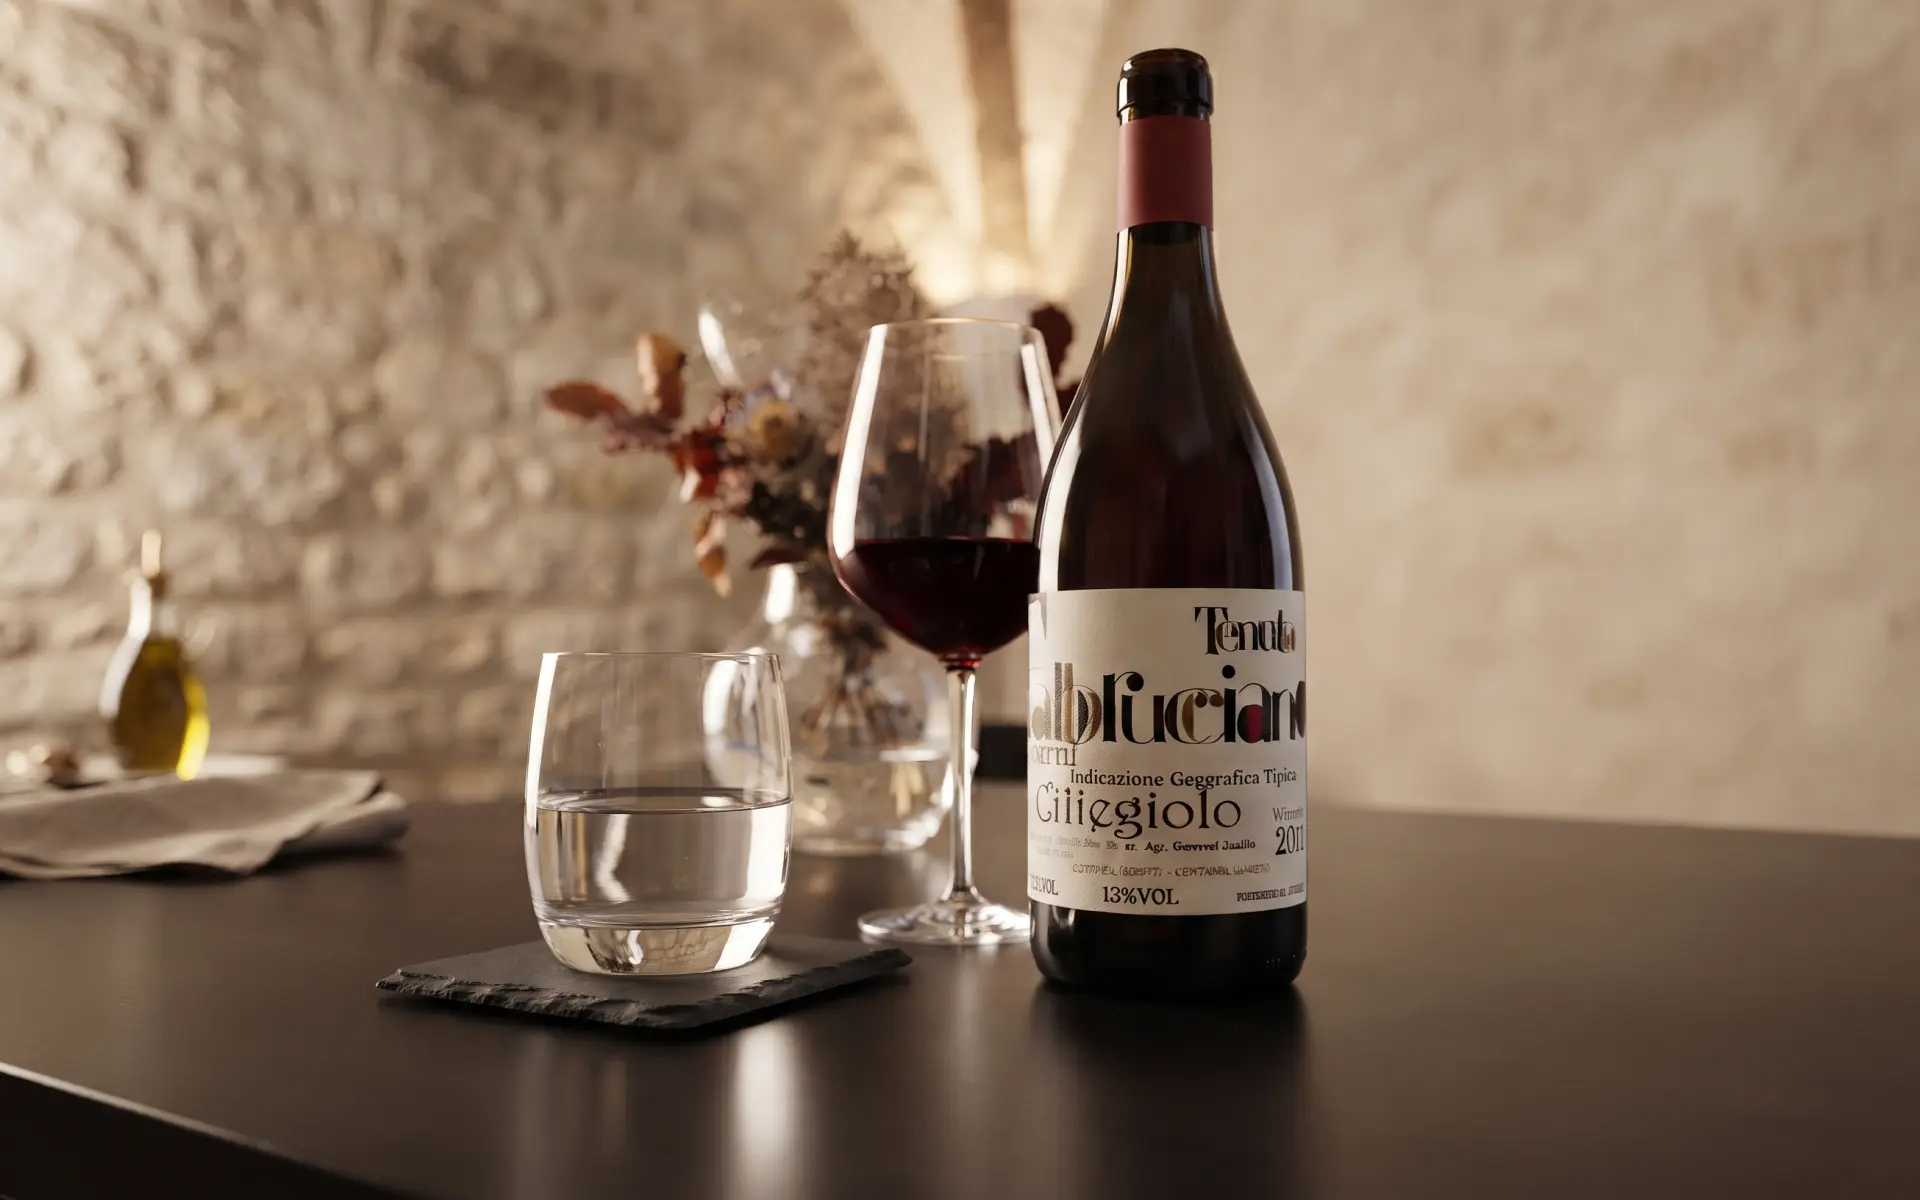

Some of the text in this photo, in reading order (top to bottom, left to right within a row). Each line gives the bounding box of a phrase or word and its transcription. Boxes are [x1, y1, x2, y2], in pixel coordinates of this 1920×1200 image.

[1070, 768, 1165, 787] Indicazione
[1263, 768, 1298, 788] Tipica
[1275, 824, 1304, 855] 2011
[1103, 885, 1180, 906] 13%VOL
